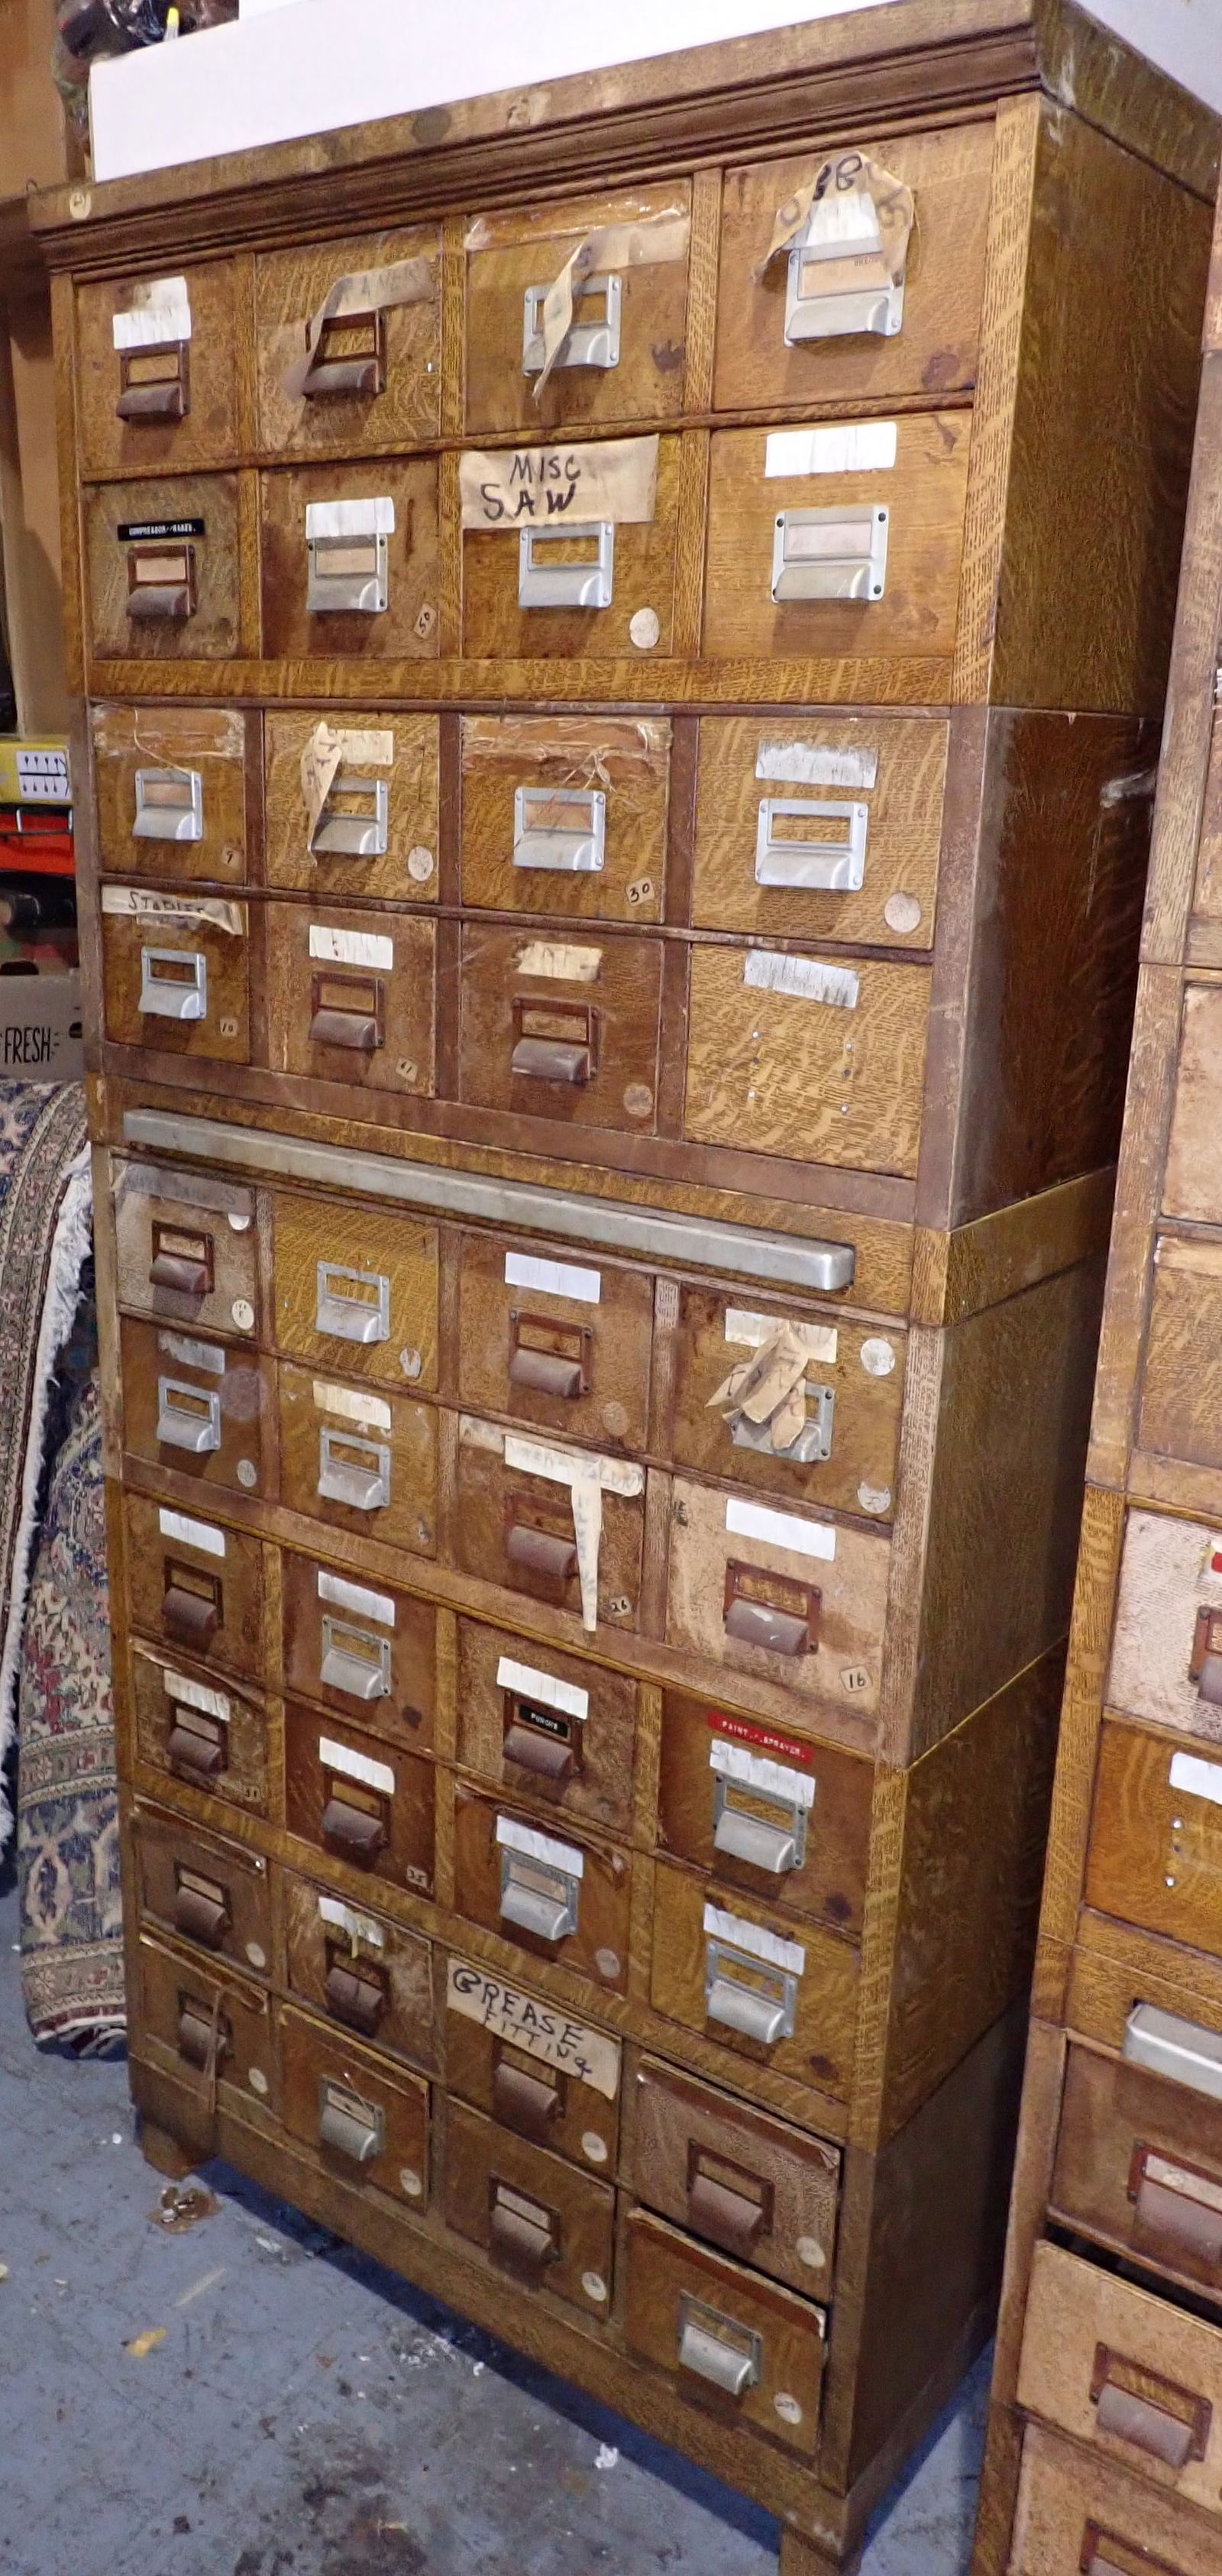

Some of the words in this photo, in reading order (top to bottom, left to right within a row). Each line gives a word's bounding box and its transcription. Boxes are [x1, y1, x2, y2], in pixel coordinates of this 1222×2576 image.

[509, 455, 581, 484] MISC
[480, 482, 577, 521] SAW
[629, 882, 649, 903] 30
[5, 1027, 50, 1063] FRESH
[849, 1672, 865, 1688] 16
[453, 1968, 584, 2048] GREASE
